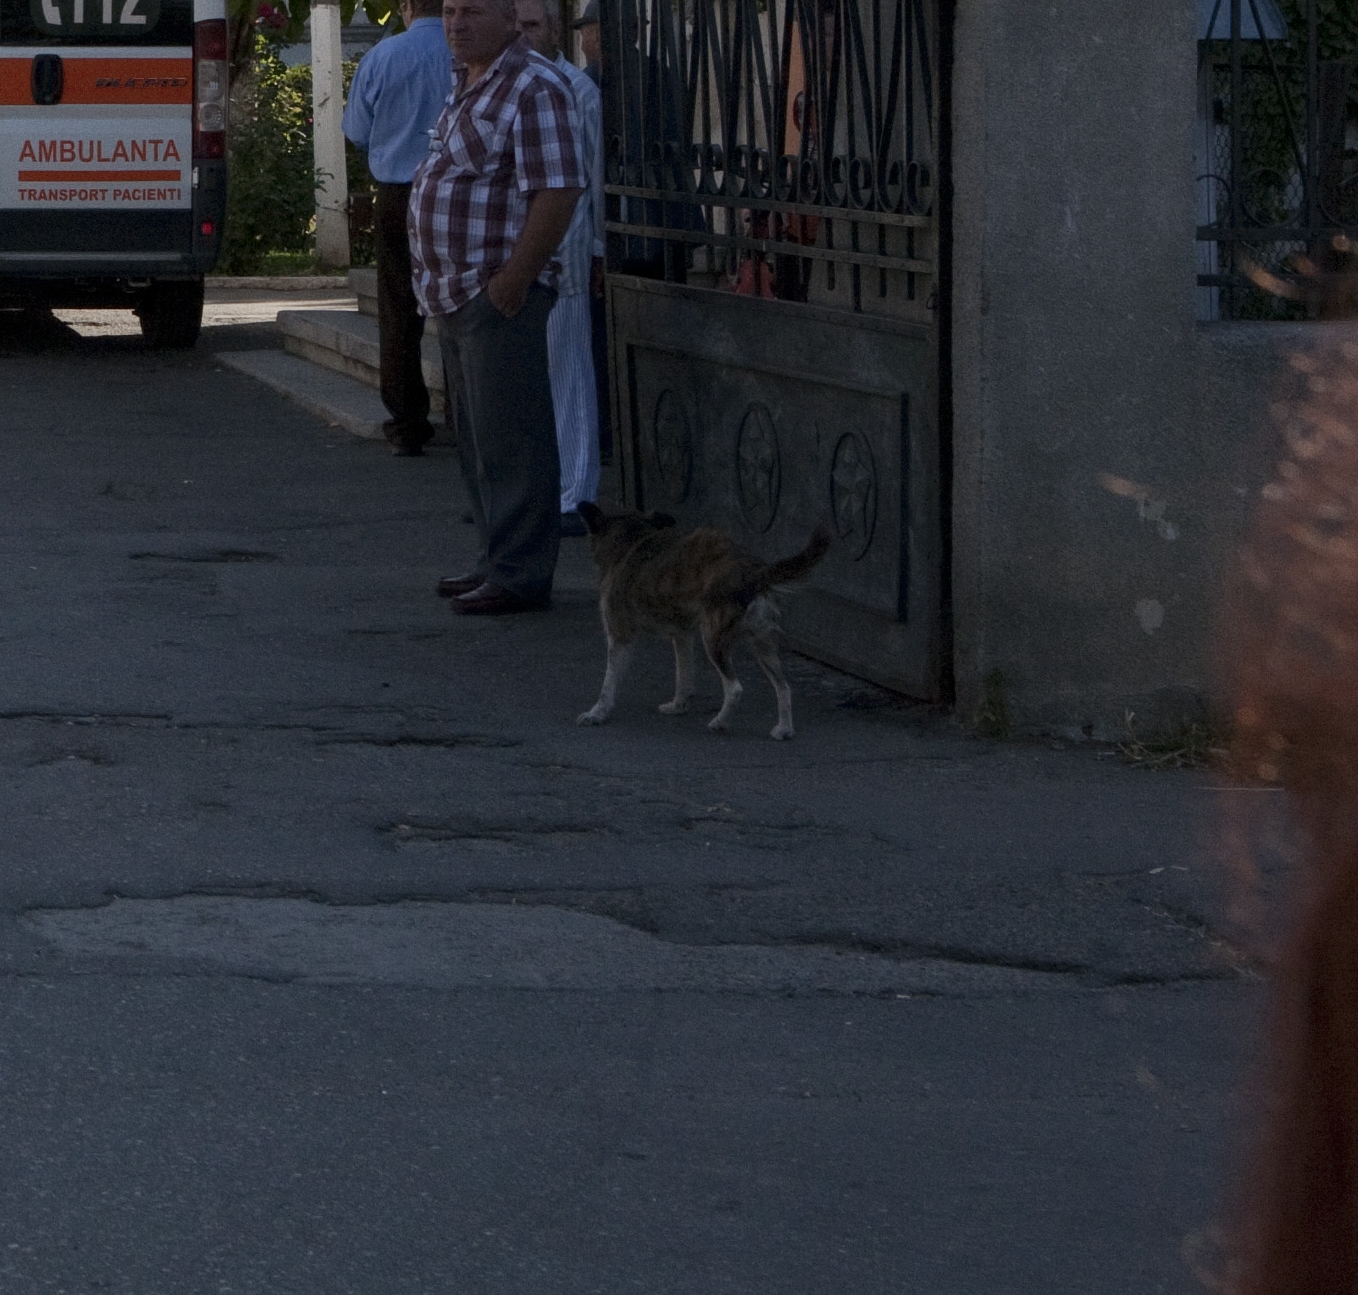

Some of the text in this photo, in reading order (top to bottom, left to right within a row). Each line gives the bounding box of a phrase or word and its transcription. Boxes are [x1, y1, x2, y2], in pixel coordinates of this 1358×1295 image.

[18, 138, 182, 163] AMBULANTA
[17, 188, 182, 202] TRANSPORT PACIENTI
